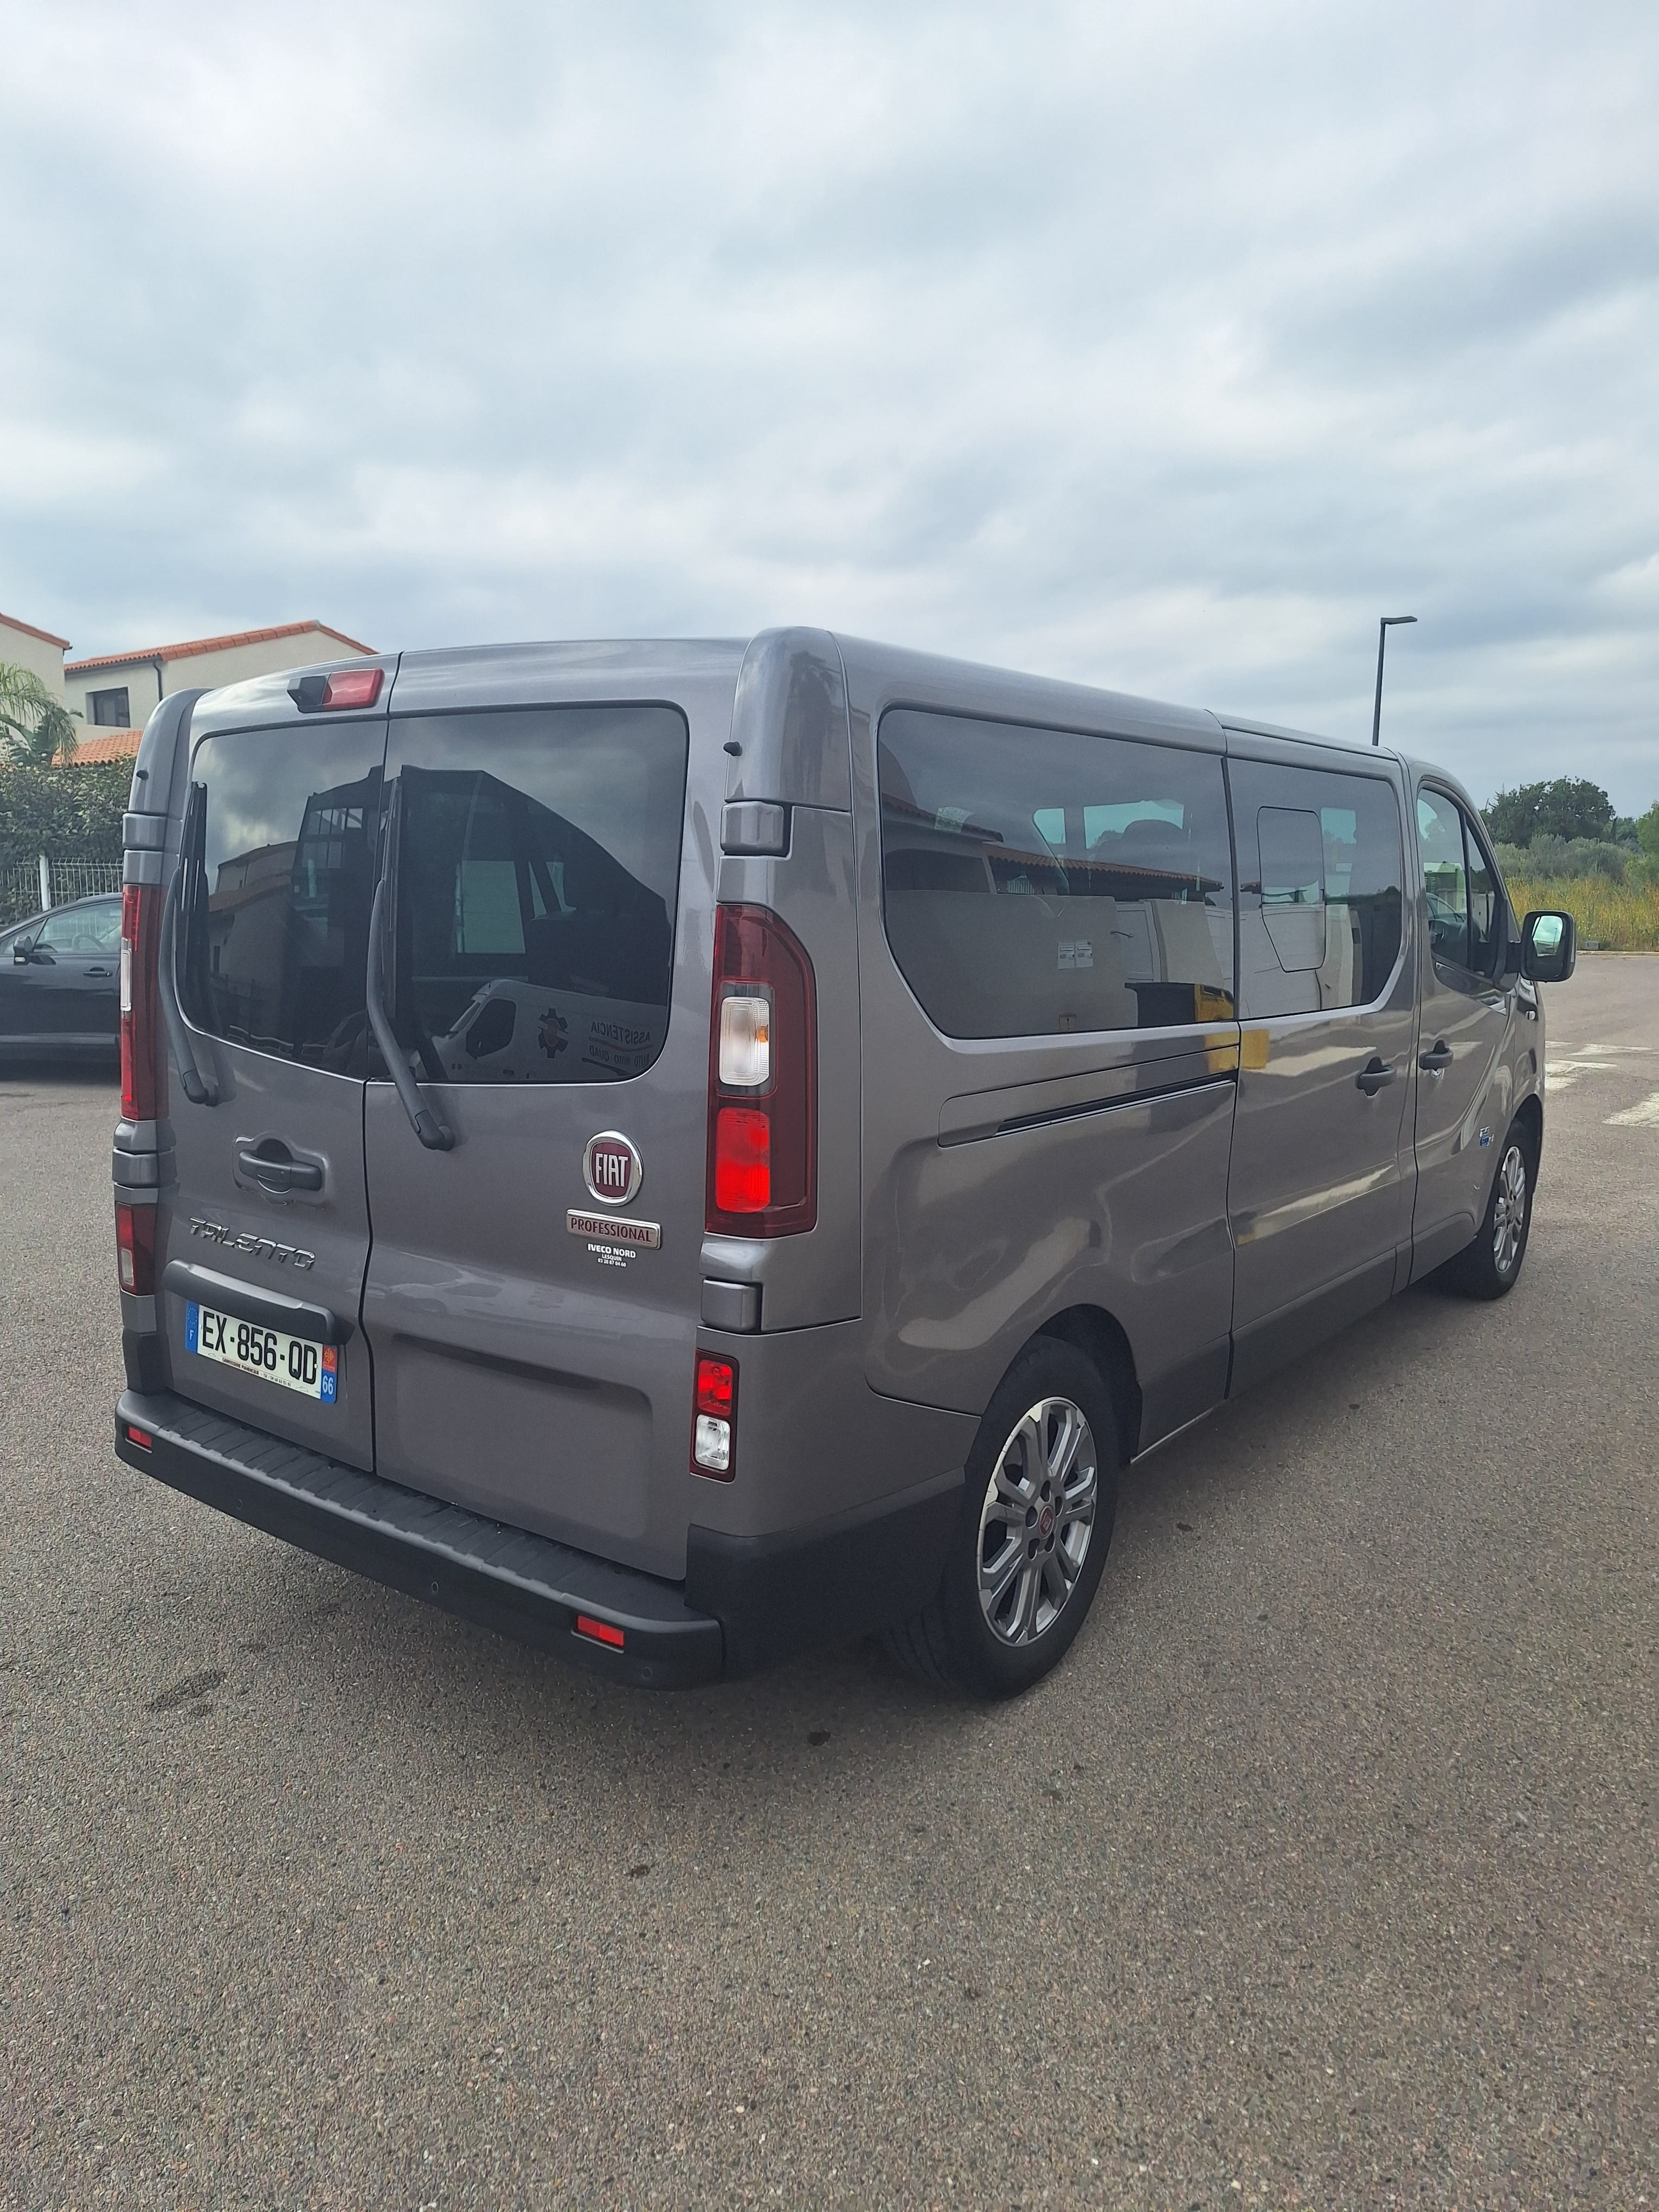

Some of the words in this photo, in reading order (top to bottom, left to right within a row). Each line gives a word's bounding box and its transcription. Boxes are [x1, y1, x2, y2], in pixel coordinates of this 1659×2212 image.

[595, 1153, 628, 1187] FIAT
[571, 1217, 652, 1243] PROFESSIONAL
[189, 1217, 315, 1270] TALENTO
[588, 1243, 612, 1254] IVECO
[613, 1248, 636, 1258] NORD
[602, 1253, 622, 1262] LESQUIN
[189, 1329, 195, 1341] F
[202, 1310, 317, 1385] EX-856-QD
[322, 1375, 334, 1395] 66
